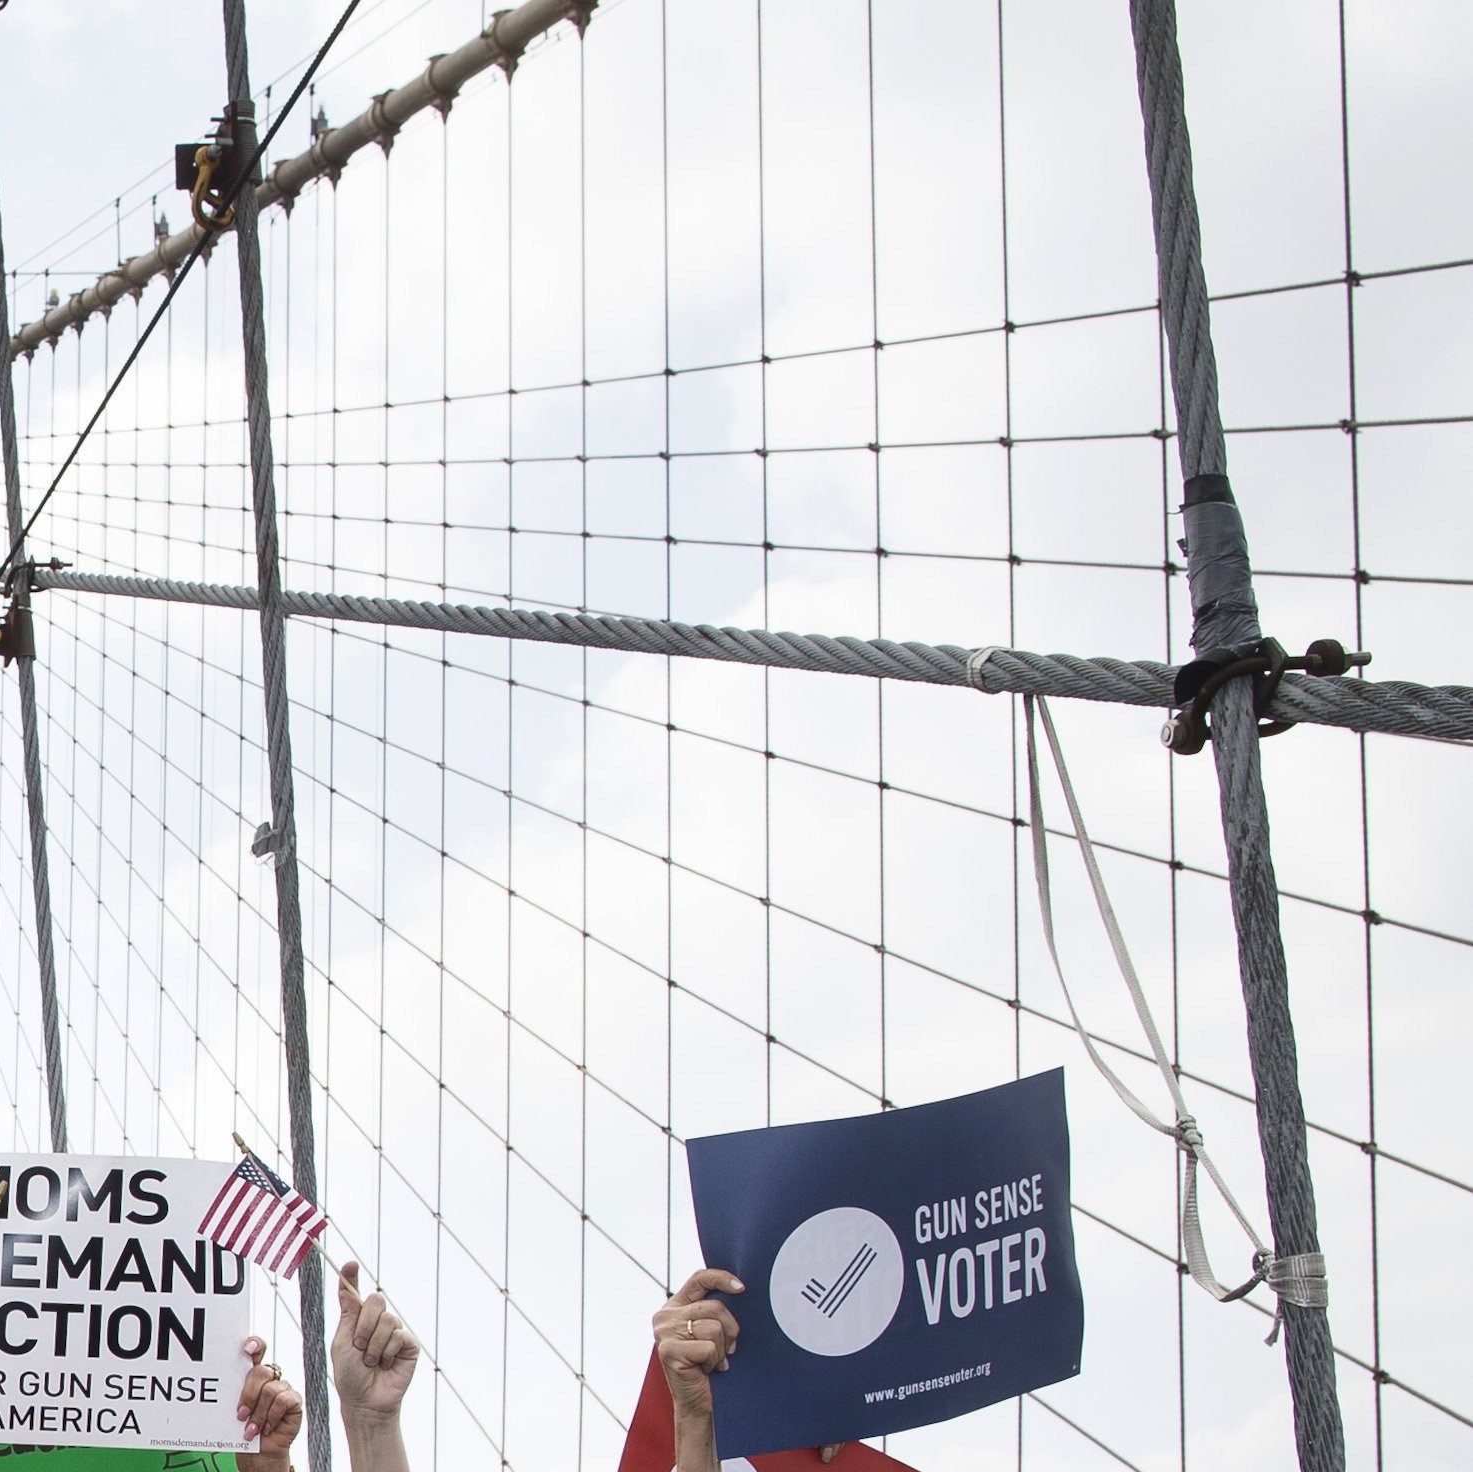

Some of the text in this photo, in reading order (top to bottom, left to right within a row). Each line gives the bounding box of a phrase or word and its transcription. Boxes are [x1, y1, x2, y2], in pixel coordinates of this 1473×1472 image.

[914, 1173, 1043, 1244] GUN SENSE
[915, 1226, 1047, 1326] VOTER
[18, 1371, 92, 1399] GUN
[104, 1375, 219, 1403] SENSE
[864, 1360, 992, 1404] www.gunsensevoter.org
[150, 1438, 250, 1451] momsdemandaction.org
